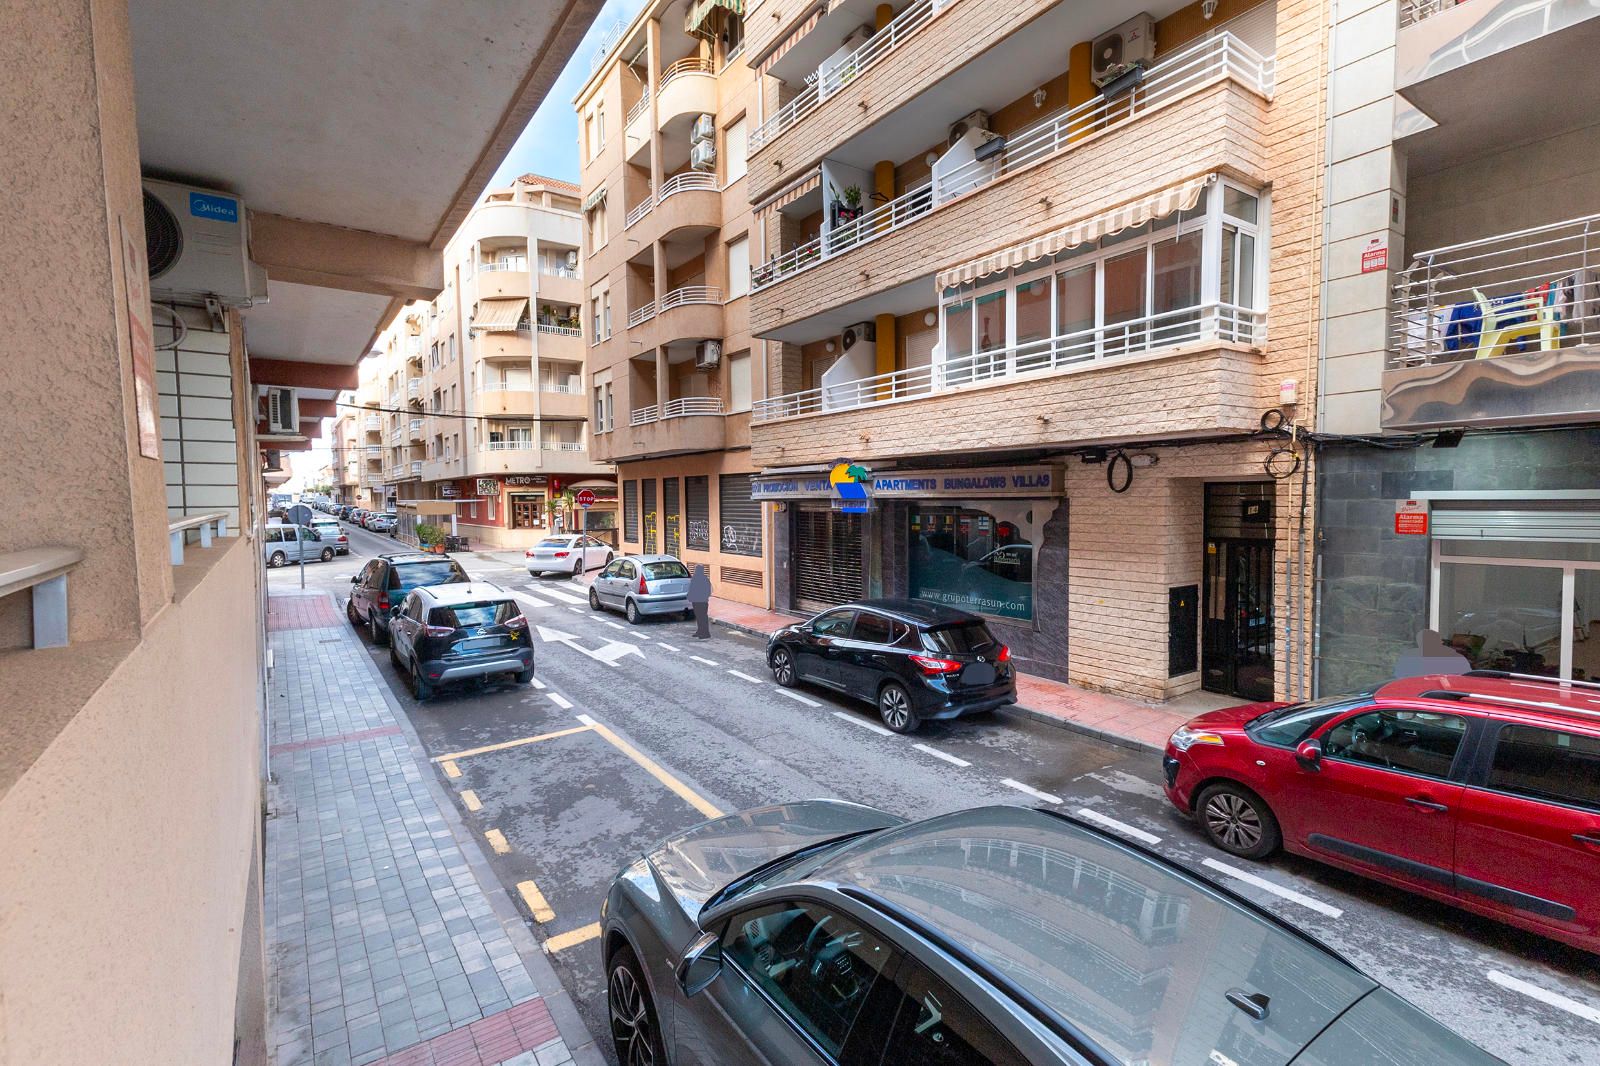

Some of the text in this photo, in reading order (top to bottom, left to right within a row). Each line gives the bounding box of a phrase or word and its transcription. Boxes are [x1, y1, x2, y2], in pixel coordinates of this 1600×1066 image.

[195, 200, 235, 216] Midea
[1364, 250, 1386, 258] Alarma
[505, 476, 531, 485] METRO
[875, 474, 1050, 490] APARTMENTS BUNGALOWS VILLAS
